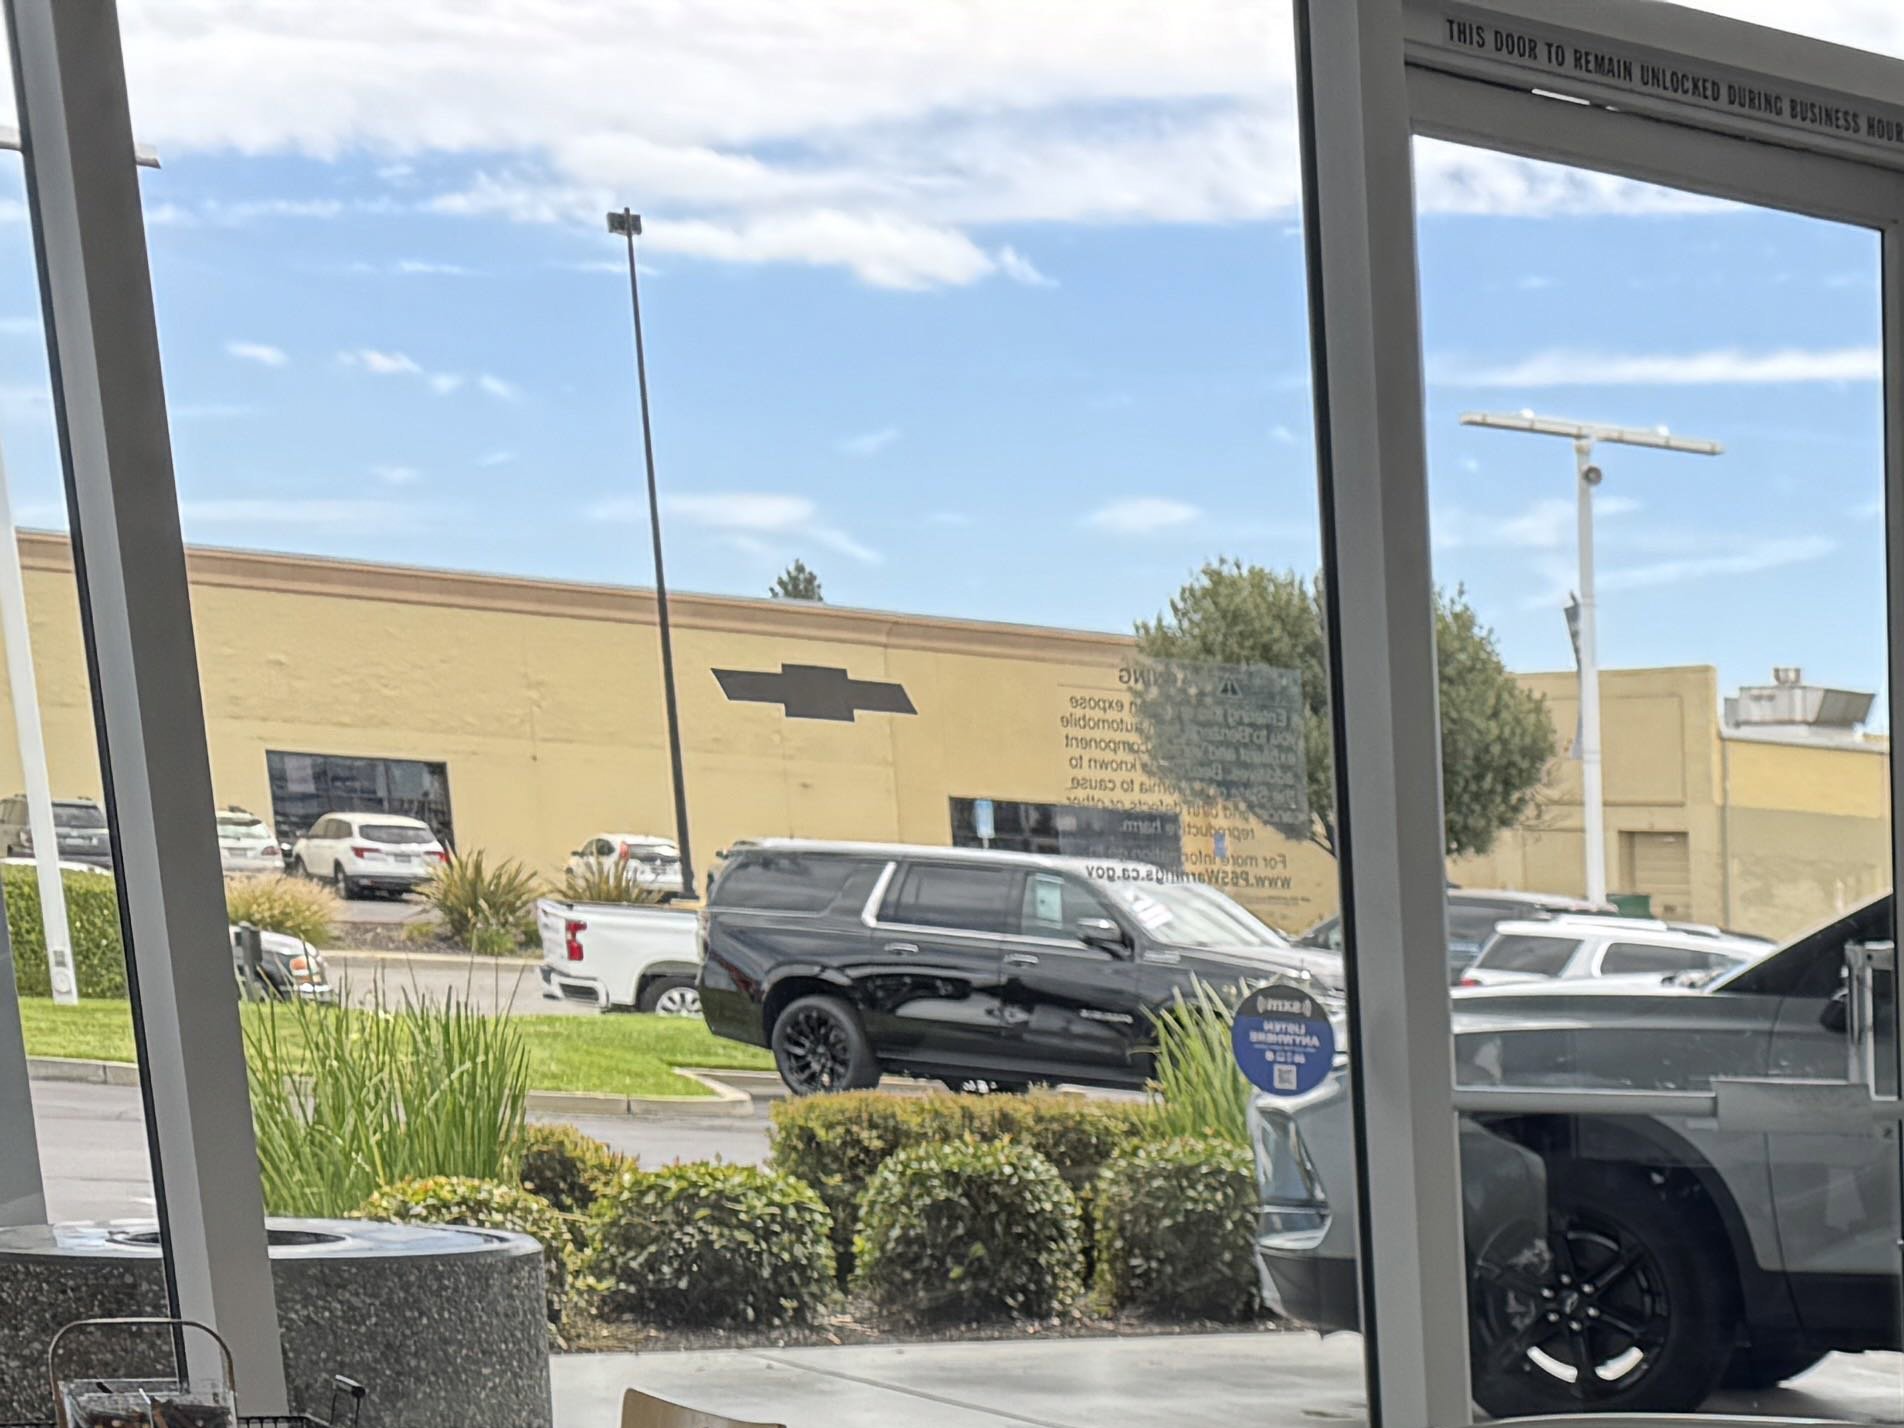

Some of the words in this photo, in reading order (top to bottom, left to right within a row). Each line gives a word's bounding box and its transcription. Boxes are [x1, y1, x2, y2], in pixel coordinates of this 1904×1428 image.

[1446, 18, 1486, 48] THIS
[1493, 29, 1538, 61] DOOR
[1545, 41, 1566, 67] TO
[1573, 48, 1633, 83] REMAIN
[1640, 63, 1721, 101] UNLOCKED
[1727, 84, 1783, 117] DURING
[1789, 98, 1861, 134] BUSINESS
